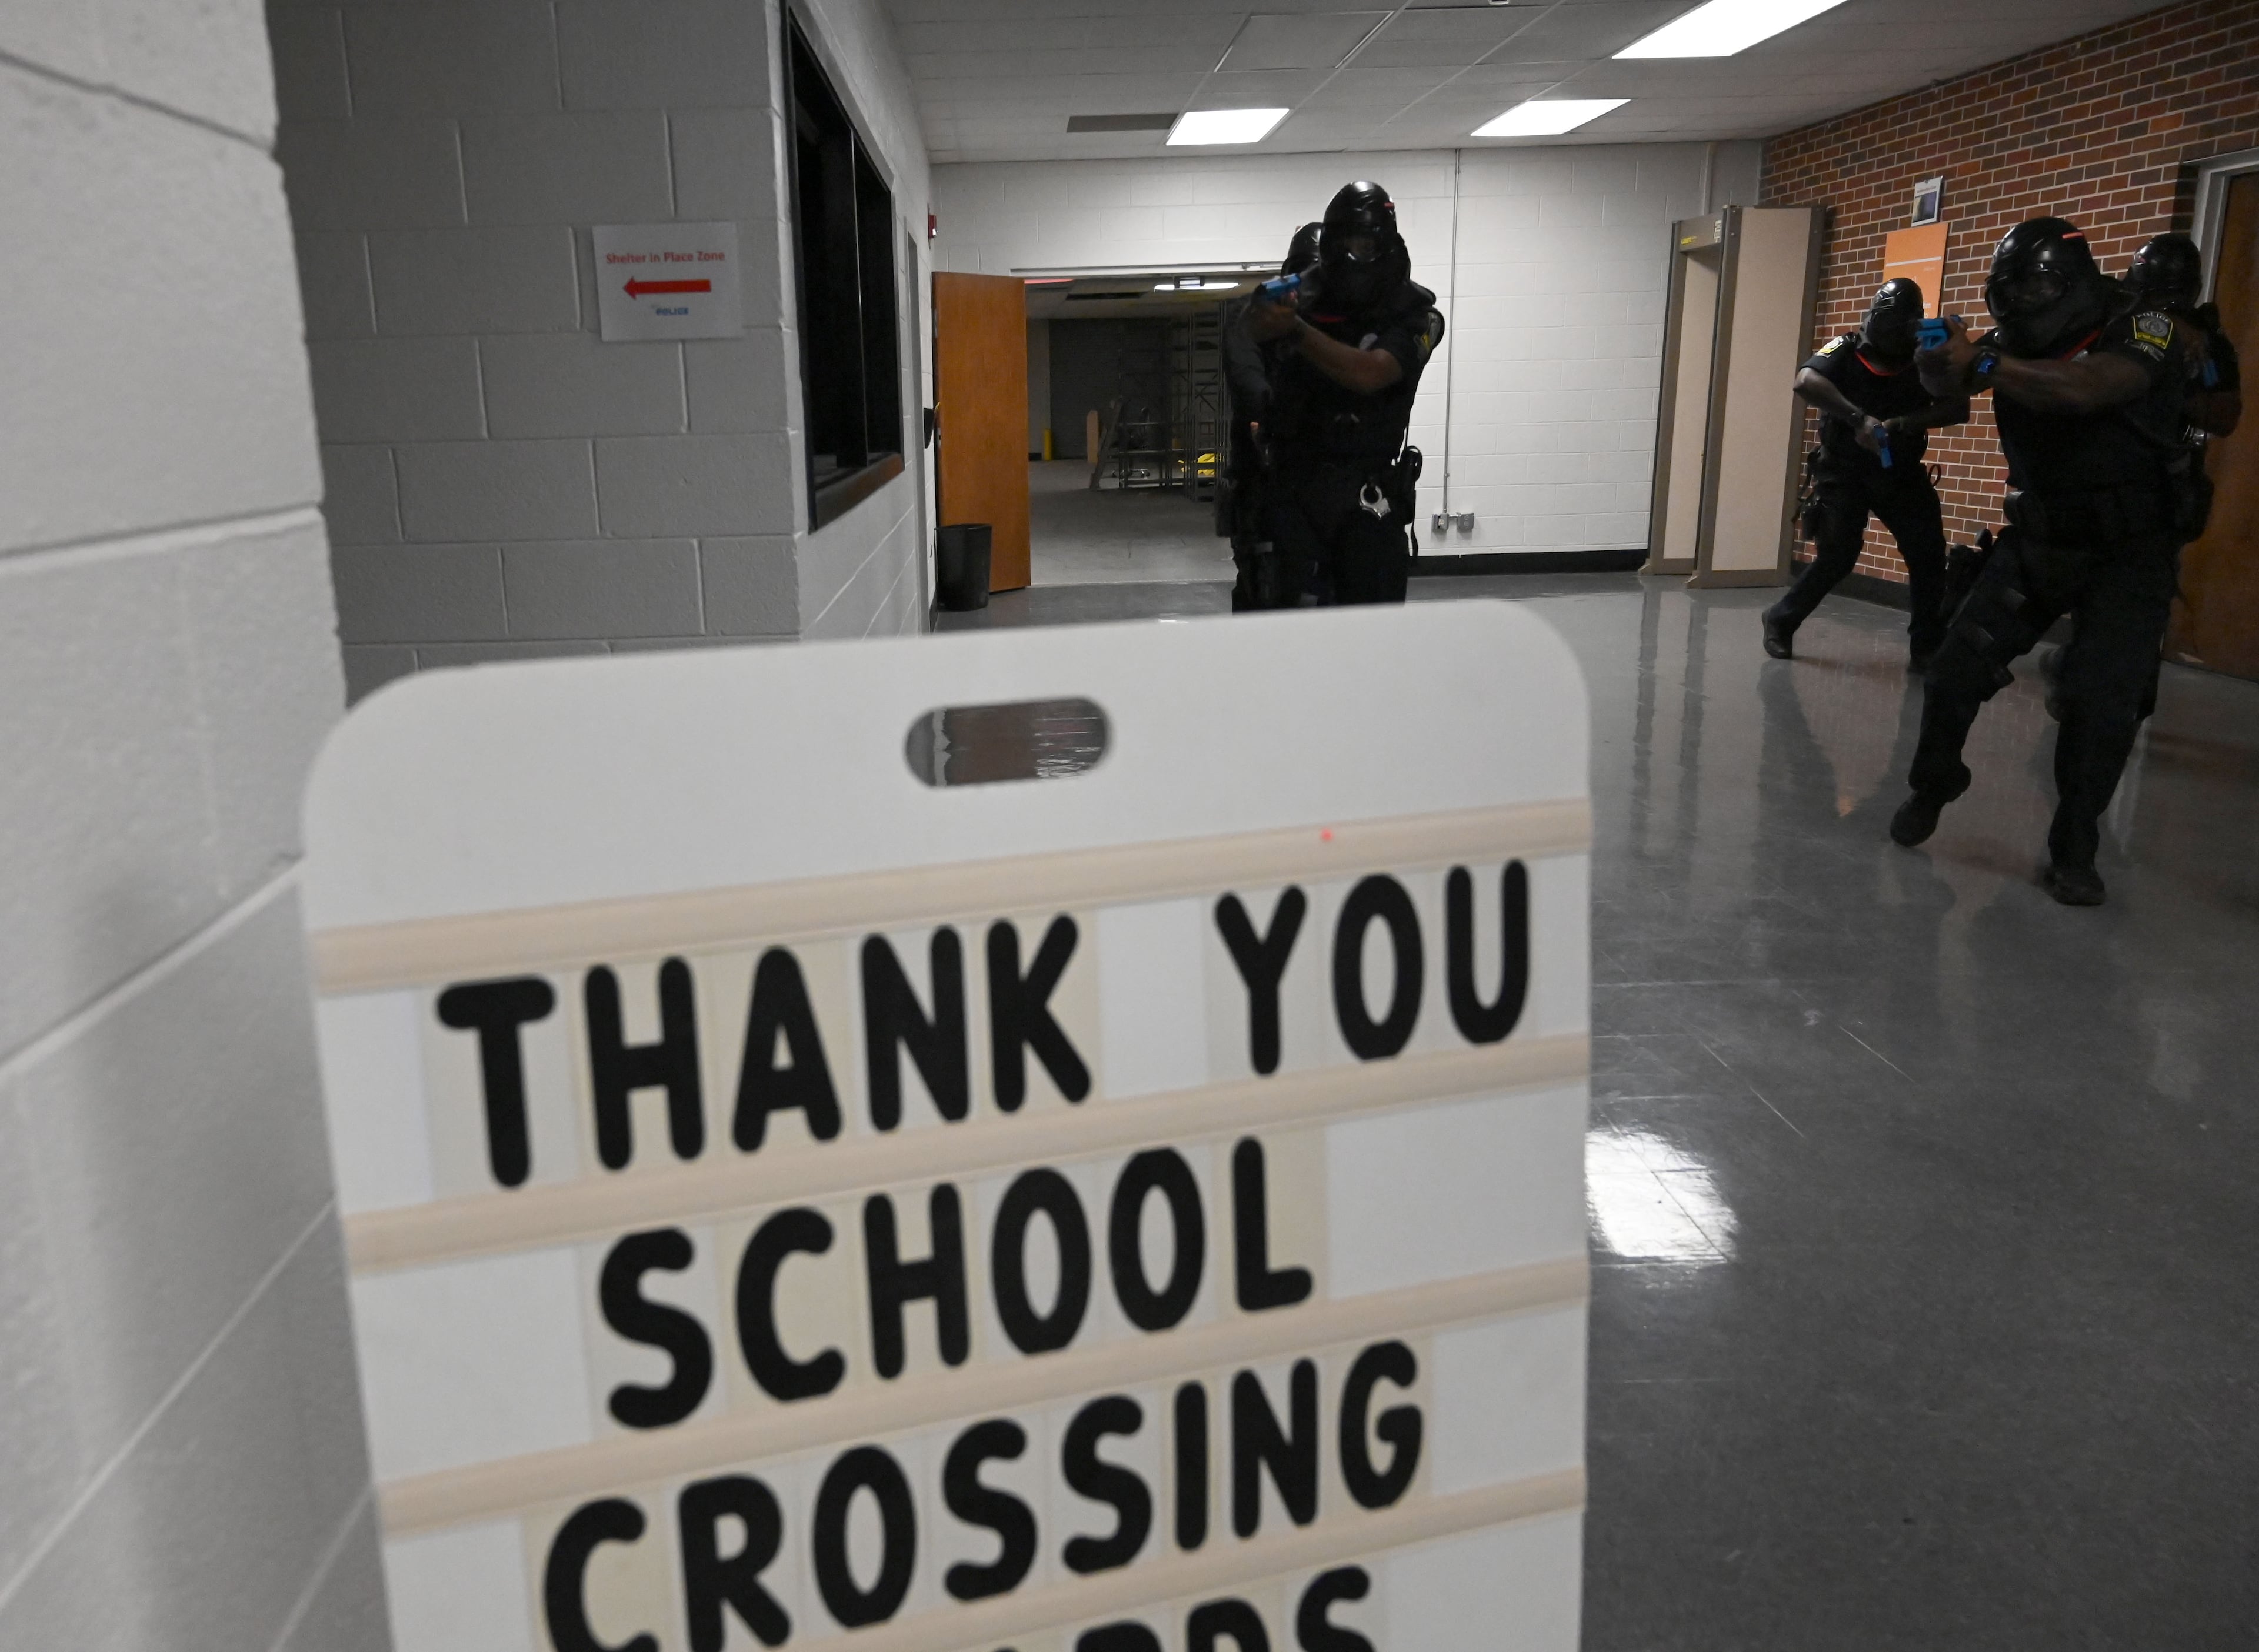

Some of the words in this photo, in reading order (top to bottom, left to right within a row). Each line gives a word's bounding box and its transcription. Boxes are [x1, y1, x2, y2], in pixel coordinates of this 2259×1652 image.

[606, 253, 645, 264] Shelter
[650, 252, 660, 263] in
[664, 252, 693, 262] Place
[698, 251, 725, 261] Zone
[436, 913, 1092, 1189] THANK
[1214, 859, 1530, 1076] YOU
[598, 1136, 1314, 1430] SCHOOL
[543, 1340, 1424, 1652] CROSSING
